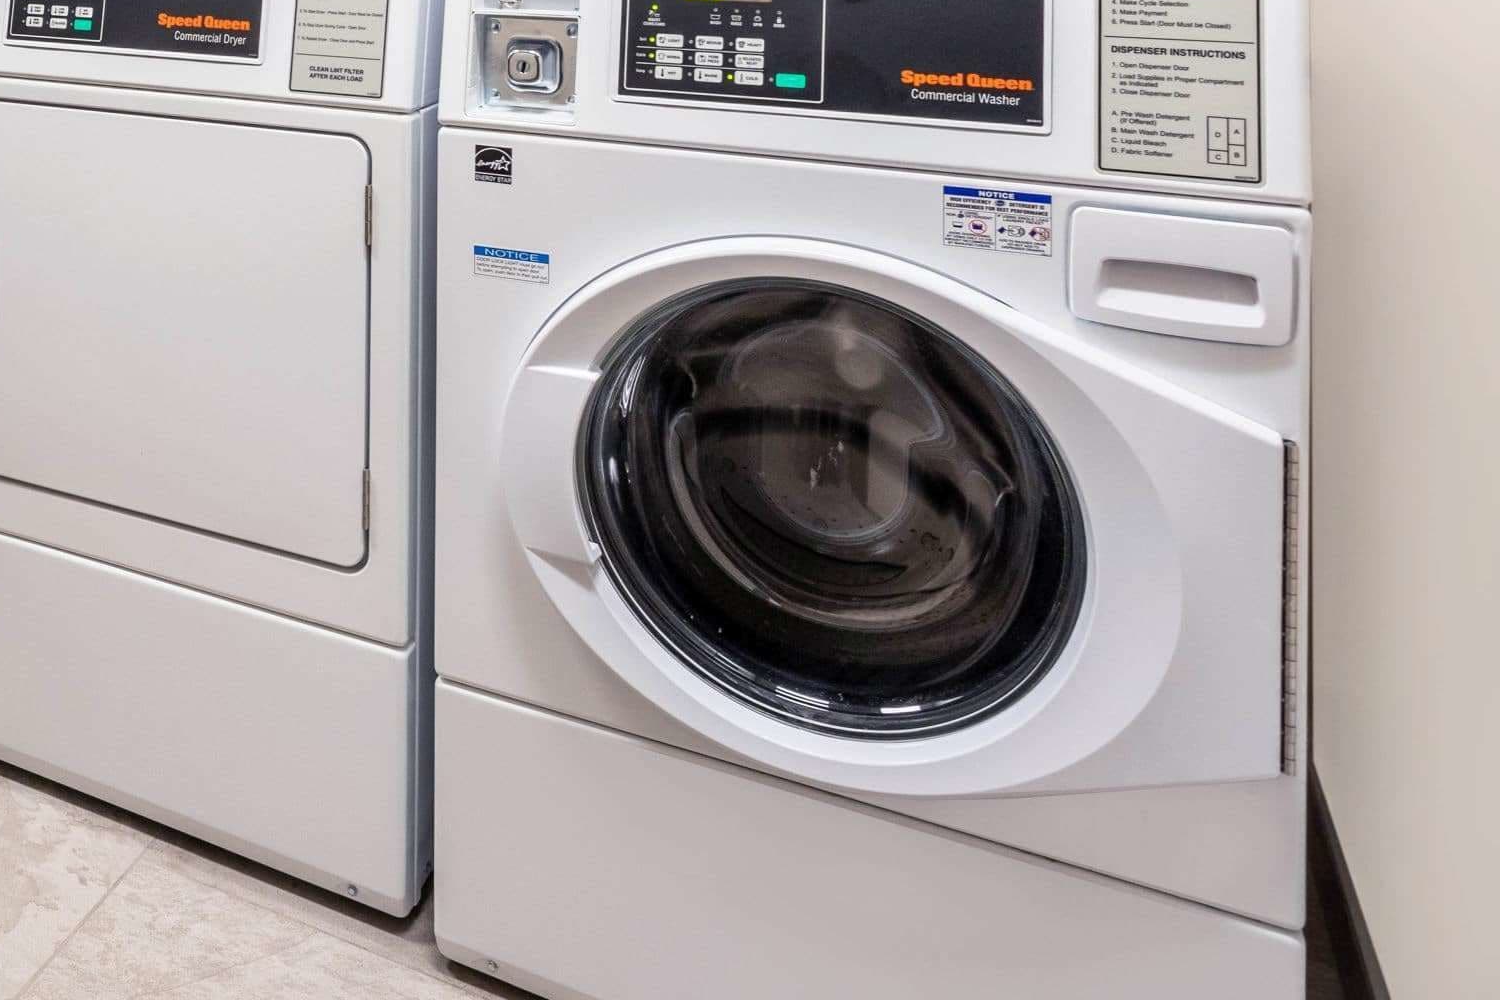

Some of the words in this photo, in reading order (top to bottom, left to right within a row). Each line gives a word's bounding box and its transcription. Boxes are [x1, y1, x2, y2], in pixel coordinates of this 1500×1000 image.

[158, 12, 202, 29] Speed
[204, 16, 250, 31] Queen
[1205, 22, 1231, 30] Closed)
[174, 30, 221, 43] Commercial
[223, 34, 246, 46] Dryer
[1111, 45, 1167, 56] DISPENSER
[1170, 49, 1245, 59] INSTRUCTIONS
[1139, 63, 1170, 71] Dispenser
[901, 69, 963, 87] Speed
[966, 73, 1033, 91] Queen
[1138, 74, 1165, 82] Supplies
[1174, 76, 1196, 84] Proper
[1198, 77, 1244, 86] Compartment
[911, 88, 975, 103] Commercial
[978, 92, 1020, 106] Washer
[1140, 89, 1172, 97] Dispenser
[1156, 113, 1190, 121] Detergent
[1160, 130, 1194, 139] Detergent
[1121, 138, 1141, 146] Liquid
[1143, 139, 1167, 147] Bleach
[1144, 150, 1172, 158] Softener
[978, 191, 1015, 199] NOTICE
[485, 248, 539, 261] NOTICE
